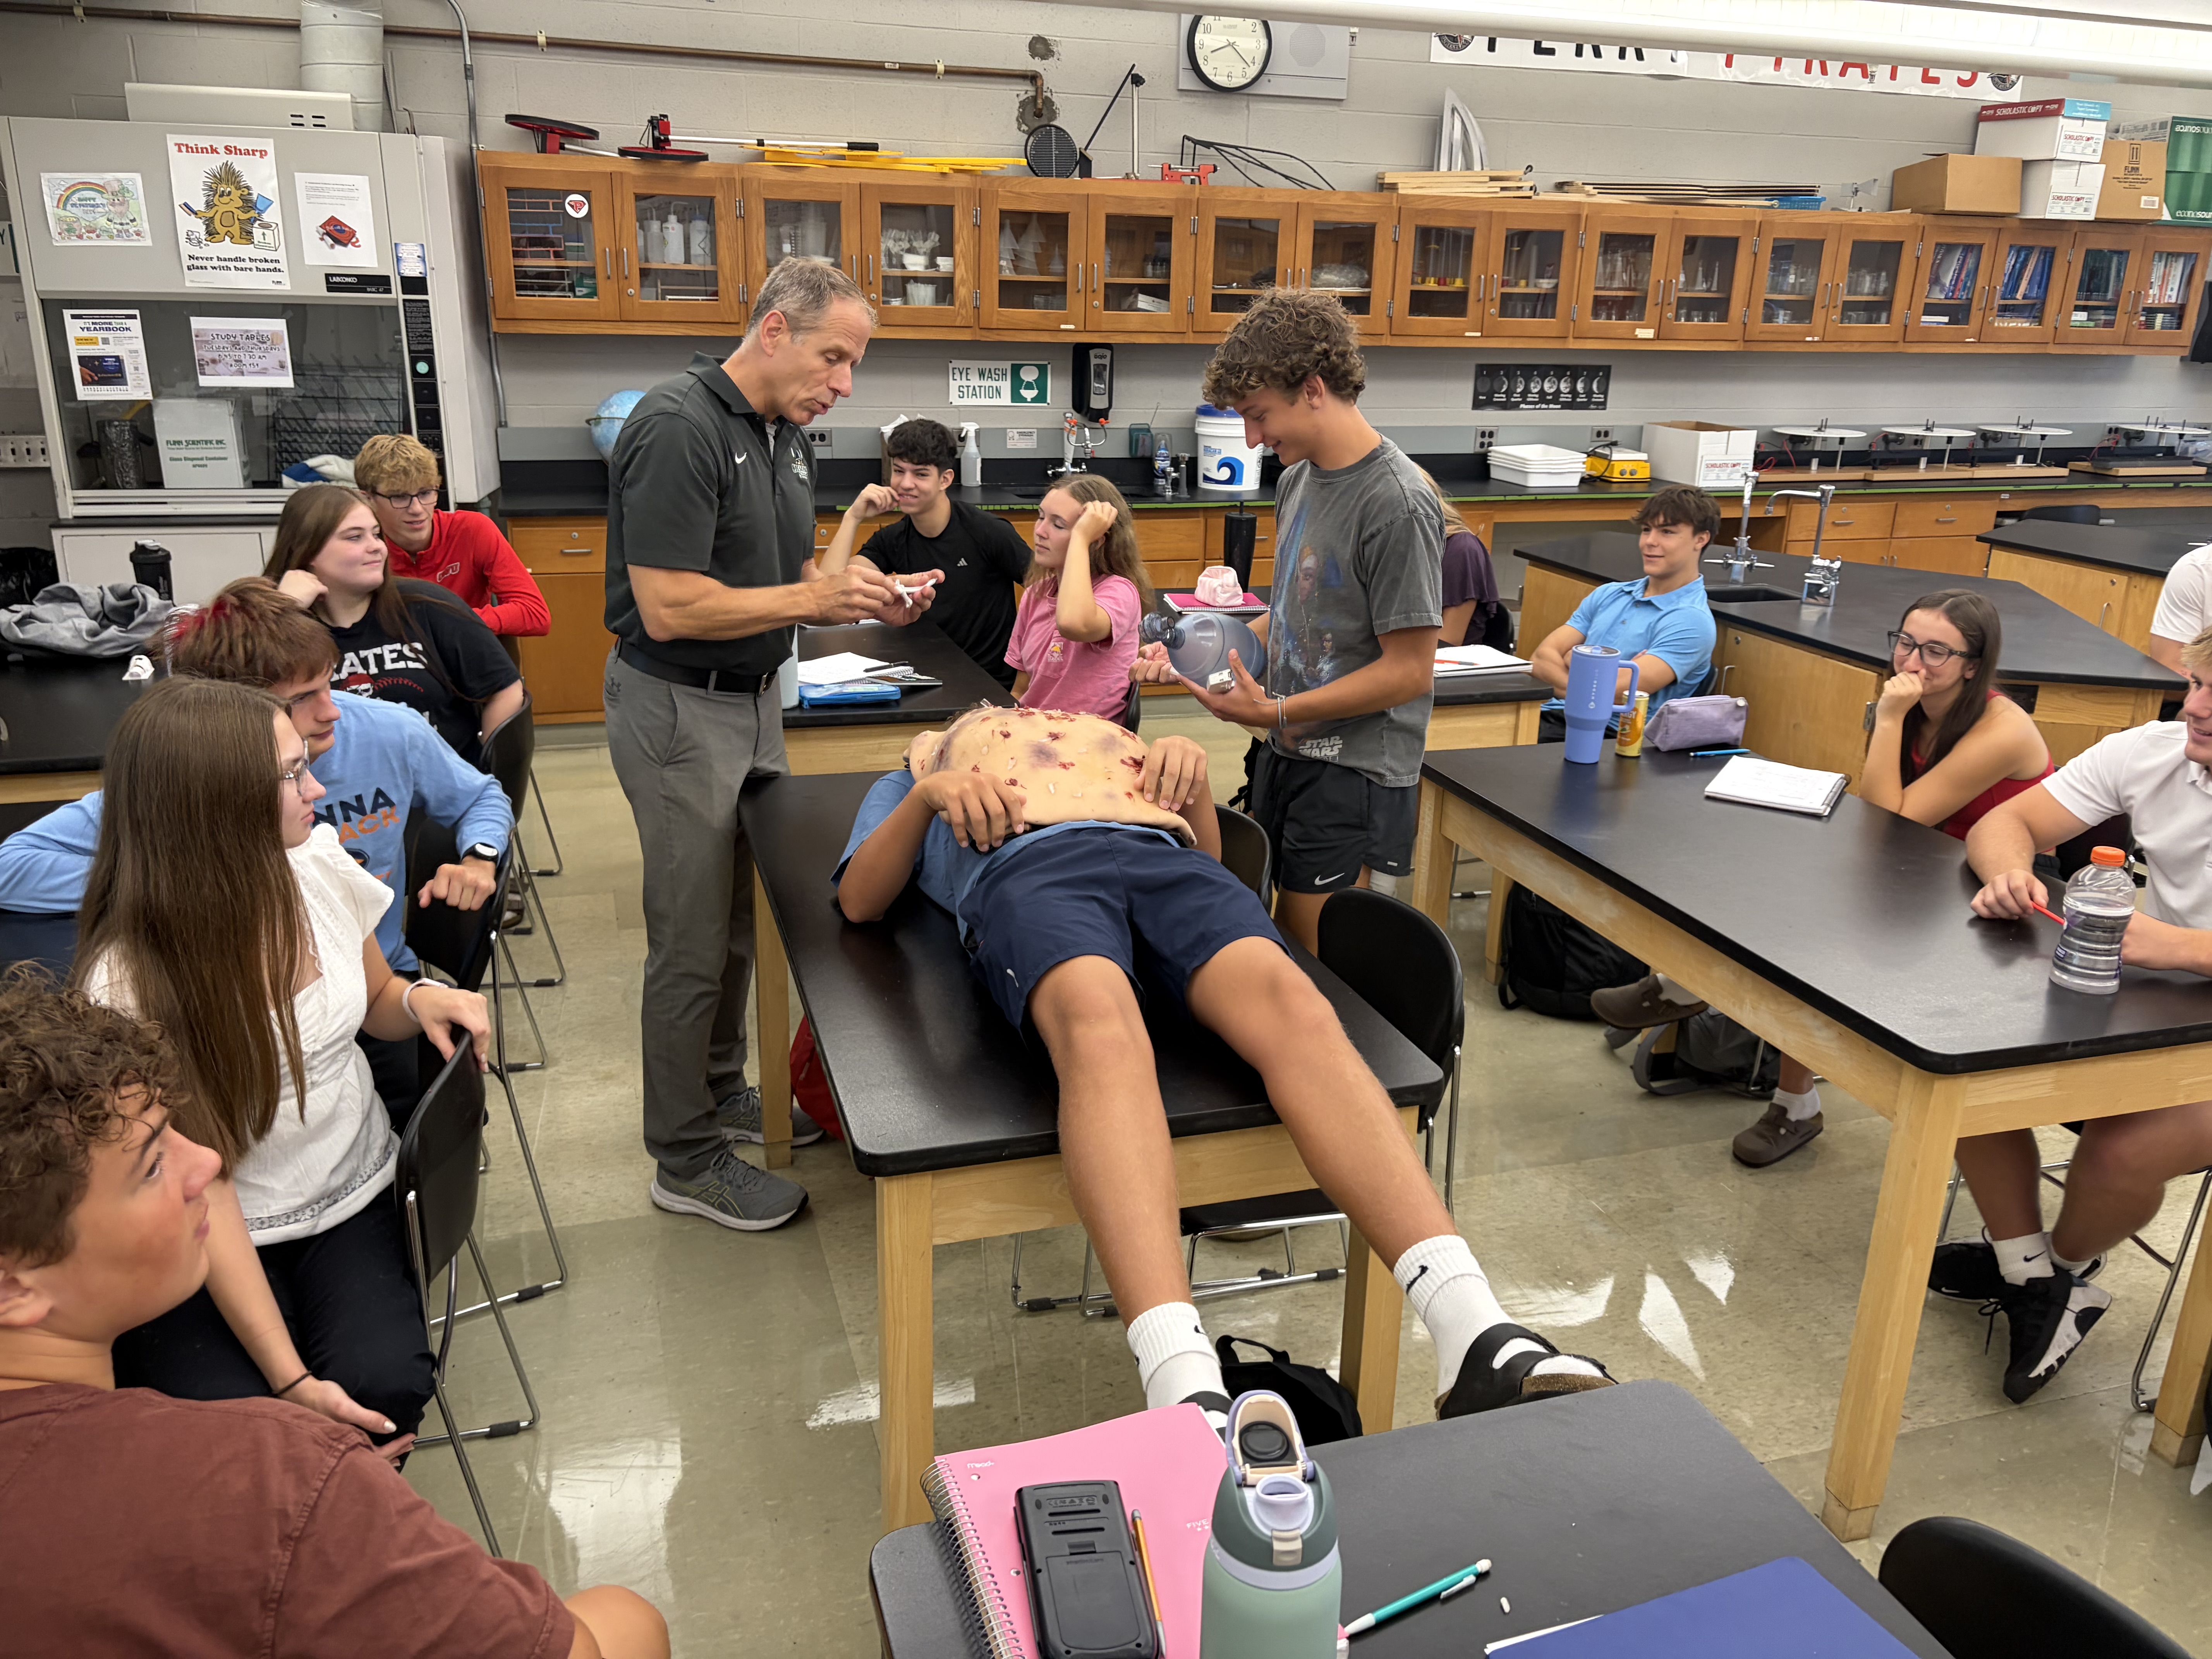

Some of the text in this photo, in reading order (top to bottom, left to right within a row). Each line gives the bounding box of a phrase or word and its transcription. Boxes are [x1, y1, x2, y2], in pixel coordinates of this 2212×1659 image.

[1202, 23, 1211, 34] 10
[1251, 22, 1257, 33] 2
[1199, 39, 1204, 50] 9
[1256, 39, 1261, 50] 3
[1203, 55, 1208, 66] 8
[1251, 56, 1255, 66] 4
[1213, 67, 1218, 77] 7
[1227, 71, 1232, 82] 6
[1242, 67, 1247, 78] 5
[174, 143, 268, 158] Think Sharp
[952, 367, 1007, 382] EYE WASH
[958, 385, 1001, 399] STATION
[330, 642, 428, 682] ATES
[1298, 736, 1343, 749] STAR
[1298, 744, 1343, 758] WARS
[1186, 1518, 1209, 1529] FIVE
